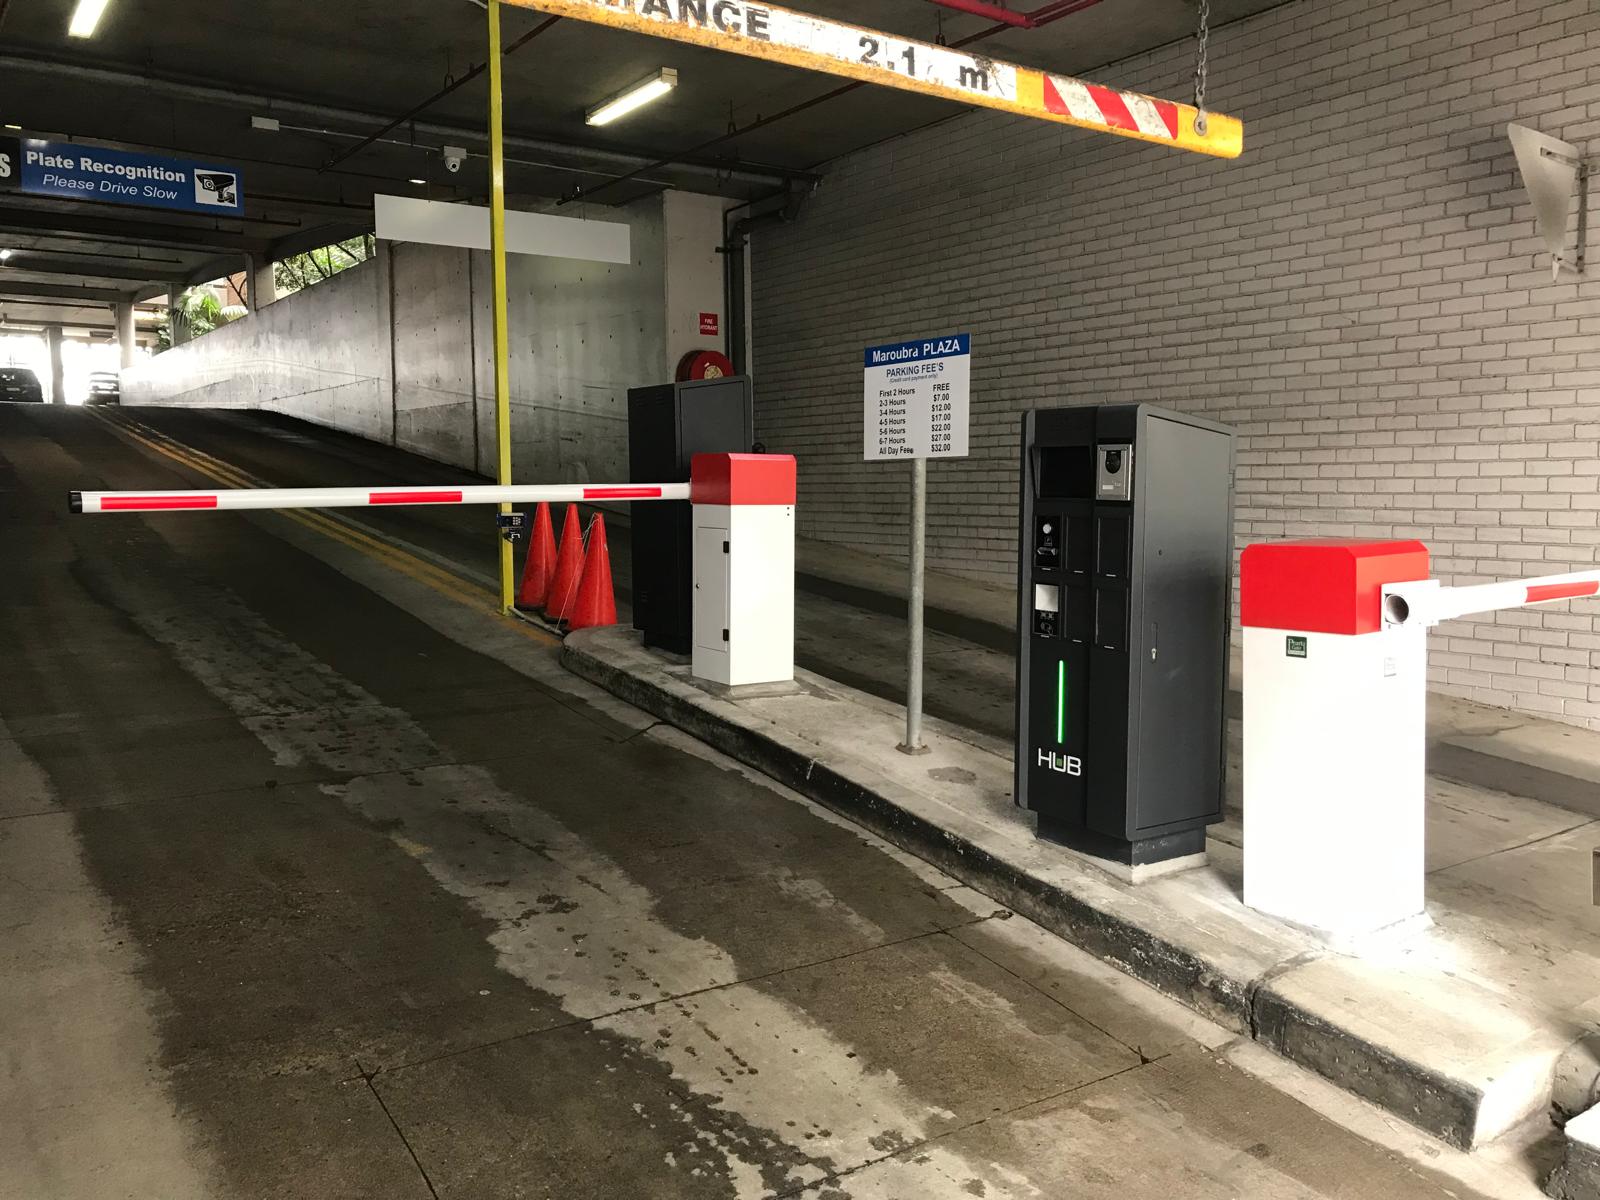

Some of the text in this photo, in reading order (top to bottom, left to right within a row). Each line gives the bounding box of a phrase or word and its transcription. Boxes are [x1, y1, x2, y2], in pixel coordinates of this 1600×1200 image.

[605, 0, 770, 41] ANCE
[859, 35, 988, 91] 2.1 m
[26, 151, 186, 183] Plate Recognition
[42, 174, 178, 200] Please Drive Slow
[873, 339, 960, 363] Maroubra PLAZA
[886, 362, 944, 378] PARKING FEE'S
[880, 389, 892, 397] First
[898, 388, 915, 396] Hours
[933, 383, 950, 391] FREE
[879, 399, 888, 407] 2-3
[933, 393, 949, 402] $7.00
[931, 403, 951, 412] $12.00
[931, 413, 951, 421] $17.00
[931, 423, 951, 432] $22.00
[931, 433, 951, 442] $27.00
[879, 447, 887, 455] All
[888, 446, 899, 456] Day
[931, 443, 951, 453] $32.00
[1037, 747, 1081, 776] HUB
